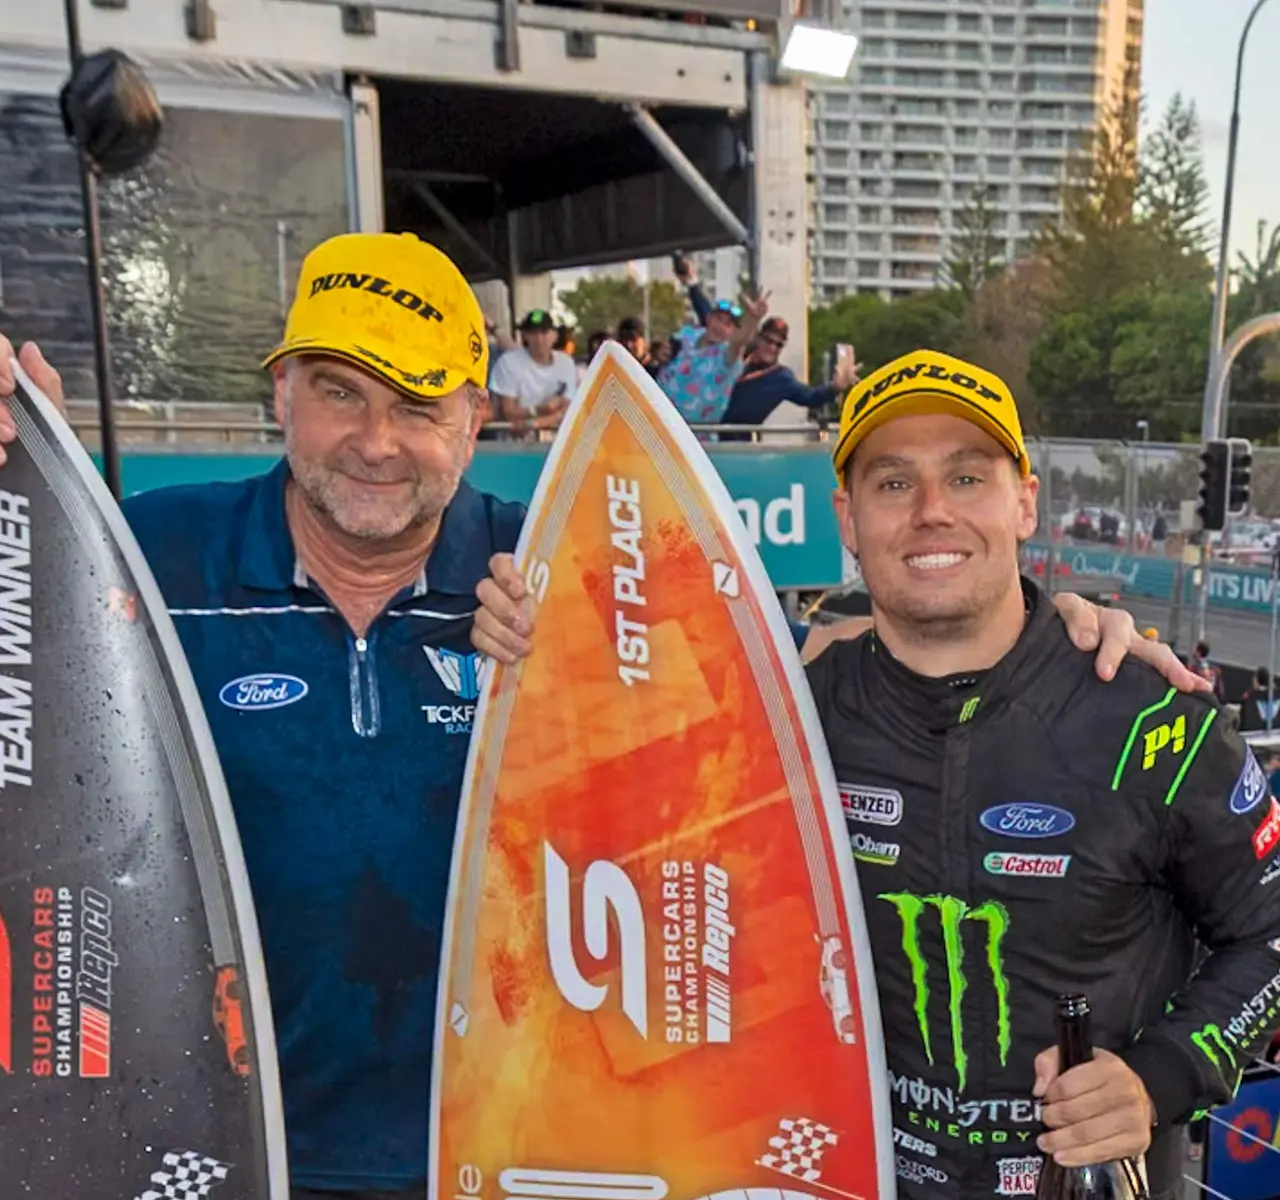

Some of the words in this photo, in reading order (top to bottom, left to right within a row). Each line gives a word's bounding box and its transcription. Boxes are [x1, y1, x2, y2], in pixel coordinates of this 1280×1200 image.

[308, 272, 444, 323] DUNLOP
[850, 363, 1002, 421] DUNLOP
[606, 475, 646, 604] PLACE
[618, 605, 651, 688] 1ST
[228, 678, 294, 707] Ford
[421, 705, 476, 723] TICKF
[445, 723, 474, 734] RAC
[1143, 715, 1186, 770] P1
[850, 795, 895, 815] ENZED
[995, 805, 1061, 834] Ford
[1004, 856, 1064, 875] Castrol
[661, 860, 682, 1044] SUPERCARS
[684, 860, 700, 1044] CHAMPIONSHIP
[33, 886, 53, 1078] SUPERCARS
[56, 886, 73, 1077] CHAMPIONSHIP
[888, 1070, 1042, 1127] MONSTE
[893, 1128, 937, 1157] TERS
[908, 1111, 1031, 1144] ENERGY
